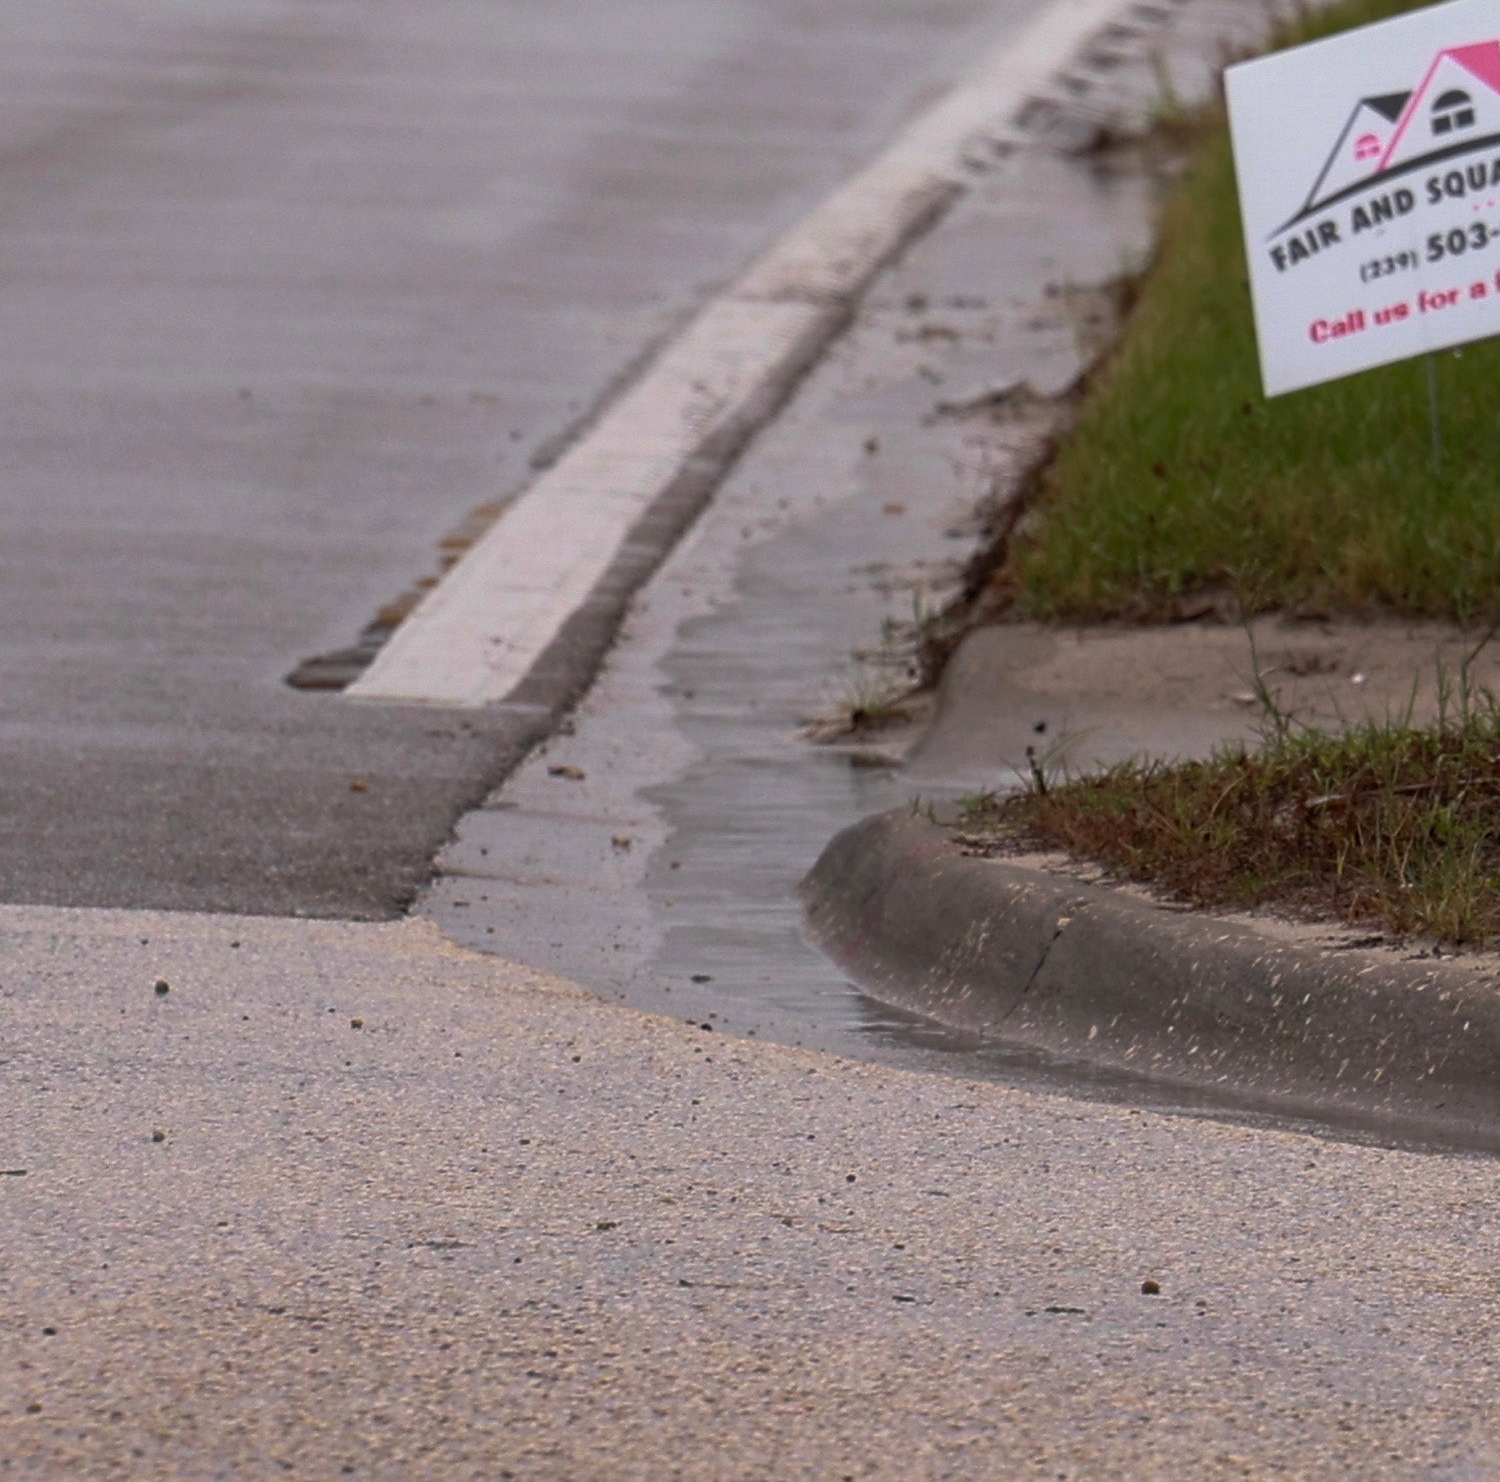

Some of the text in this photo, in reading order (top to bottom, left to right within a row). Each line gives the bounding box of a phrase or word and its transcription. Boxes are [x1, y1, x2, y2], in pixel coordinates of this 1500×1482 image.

[1268, 217, 1342, 274] FAIR
[1350, 187, 1416, 235] AND
[1359, 249, 1420, 284] (239)
[1308, 309, 1366, 345] Call
[1373, 300, 1410, 326] us
[1416, 288, 1460, 314] for
[1469, 280, 1488, 300] a
